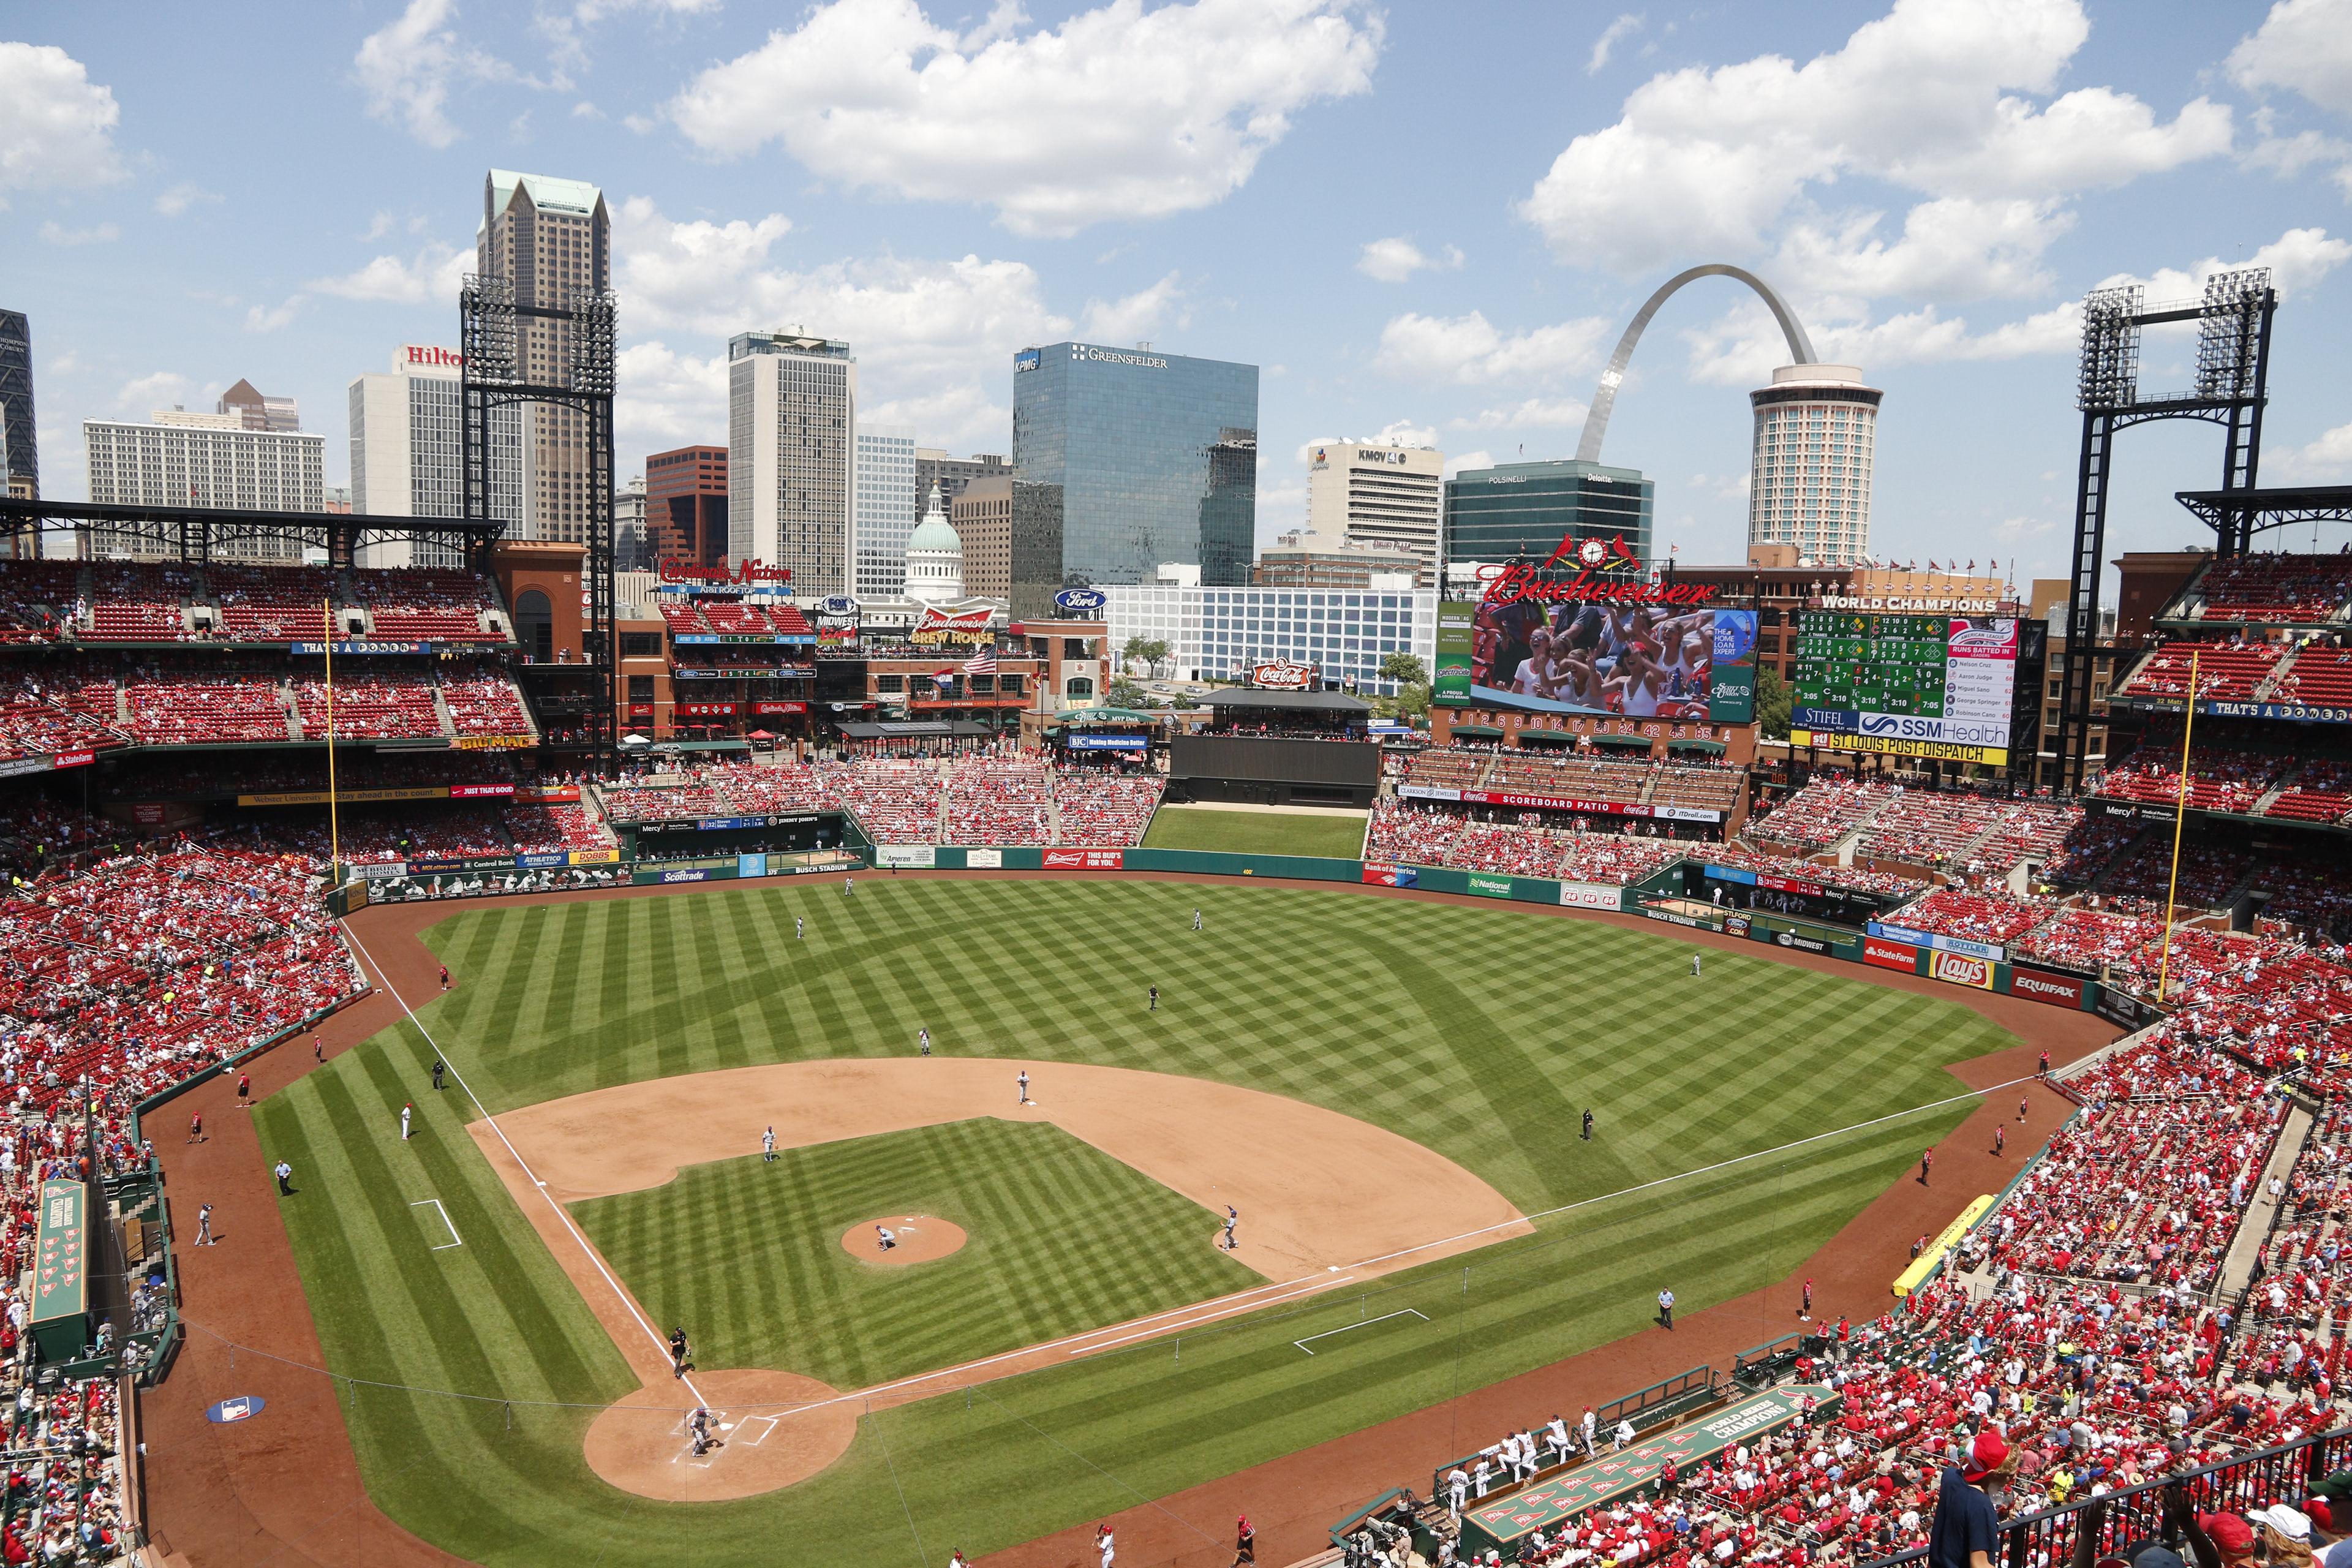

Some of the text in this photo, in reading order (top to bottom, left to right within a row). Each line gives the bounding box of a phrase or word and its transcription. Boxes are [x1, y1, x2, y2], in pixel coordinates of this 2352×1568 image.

[1088, 348, 1167, 369] GREENSFELDER
[1015, 358, 1036, 373] KPMG
[1359, 449, 1386, 462] KMOV
[1588, 473, 1613, 483] Deloitte.
[660, 557, 791, 584] Cardinals Nation
[1476, 564, 1716, 603] Budweiser
[1066, 591, 1098, 606] Ford
[1821, 595, 1997, 612] WORLD CHAMPIONS
[817, 616, 859, 625] MIDWEST
[916, 614, 995, 630] Budweiser
[821, 626, 856, 641] Live!
[911, 632, 995, 644] BREW HOUSE
[344, 643, 352, 653] A
[1260, 667, 1303, 683] Coca-Cola
[1437, 669, 1471, 677] Spectracide
[1806, 707, 1844, 725] STIFEL
[2216, 703, 2348, 721] THAT'S A POWER
[1481, 715, 1711, 740] 2 6 9 10 14 17 20 24 42 45 85
[461, 736, 529, 750] BIG MAC
[1833, 735, 1984, 761] ST. LOUIS POST-DISPATCH
[65, 754, 92, 764] StateFarm
[1463, 792, 1488, 802] Coca-Cola
[1503, 796, 1609, 811] SCOREBOARD PATIO
[1623, 805, 1651, 815] Coca-Cola
[2106, 806, 2131, 818] Mercy
[643, 823, 662, 833] Mercy
[579, 851, 609, 860] DOBBS
[665, 870, 704, 881] Scottrade
[1389, 866, 1416, 875] America
[1479, 880, 1510, 891] National
[1825, 890, 1845, 900] Mercy
[1648, 911, 1696, 927] BUSCH STADIUM
[1724, 910, 1751, 920] STLFORD
[1883, 925, 1922, 940] American Eagle
[1793, 938, 1824, 950] MIDWEST
[1948, 940, 1988, 952] ROTTLER
[1876, 949, 1915, 963] StateFarm
[1937, 953, 1985, 982] Lay's
[2015, 977, 2076, 998] EQUIFAX
[1702, 1399, 1775, 1433] WORLD SERIES
[1713, 1404, 1788, 1439] CHAMPIONS
[1637, 1448, 1654, 1457] 1982
[1601, 1463, 1619, 1472] 1964
[1564, 1477, 1582, 1487] 1944
[1525, 1494, 1544, 1503] 1934
[1555, 1497, 1574, 1506] 1942
[1485, 1510, 1505, 1519] 1926
